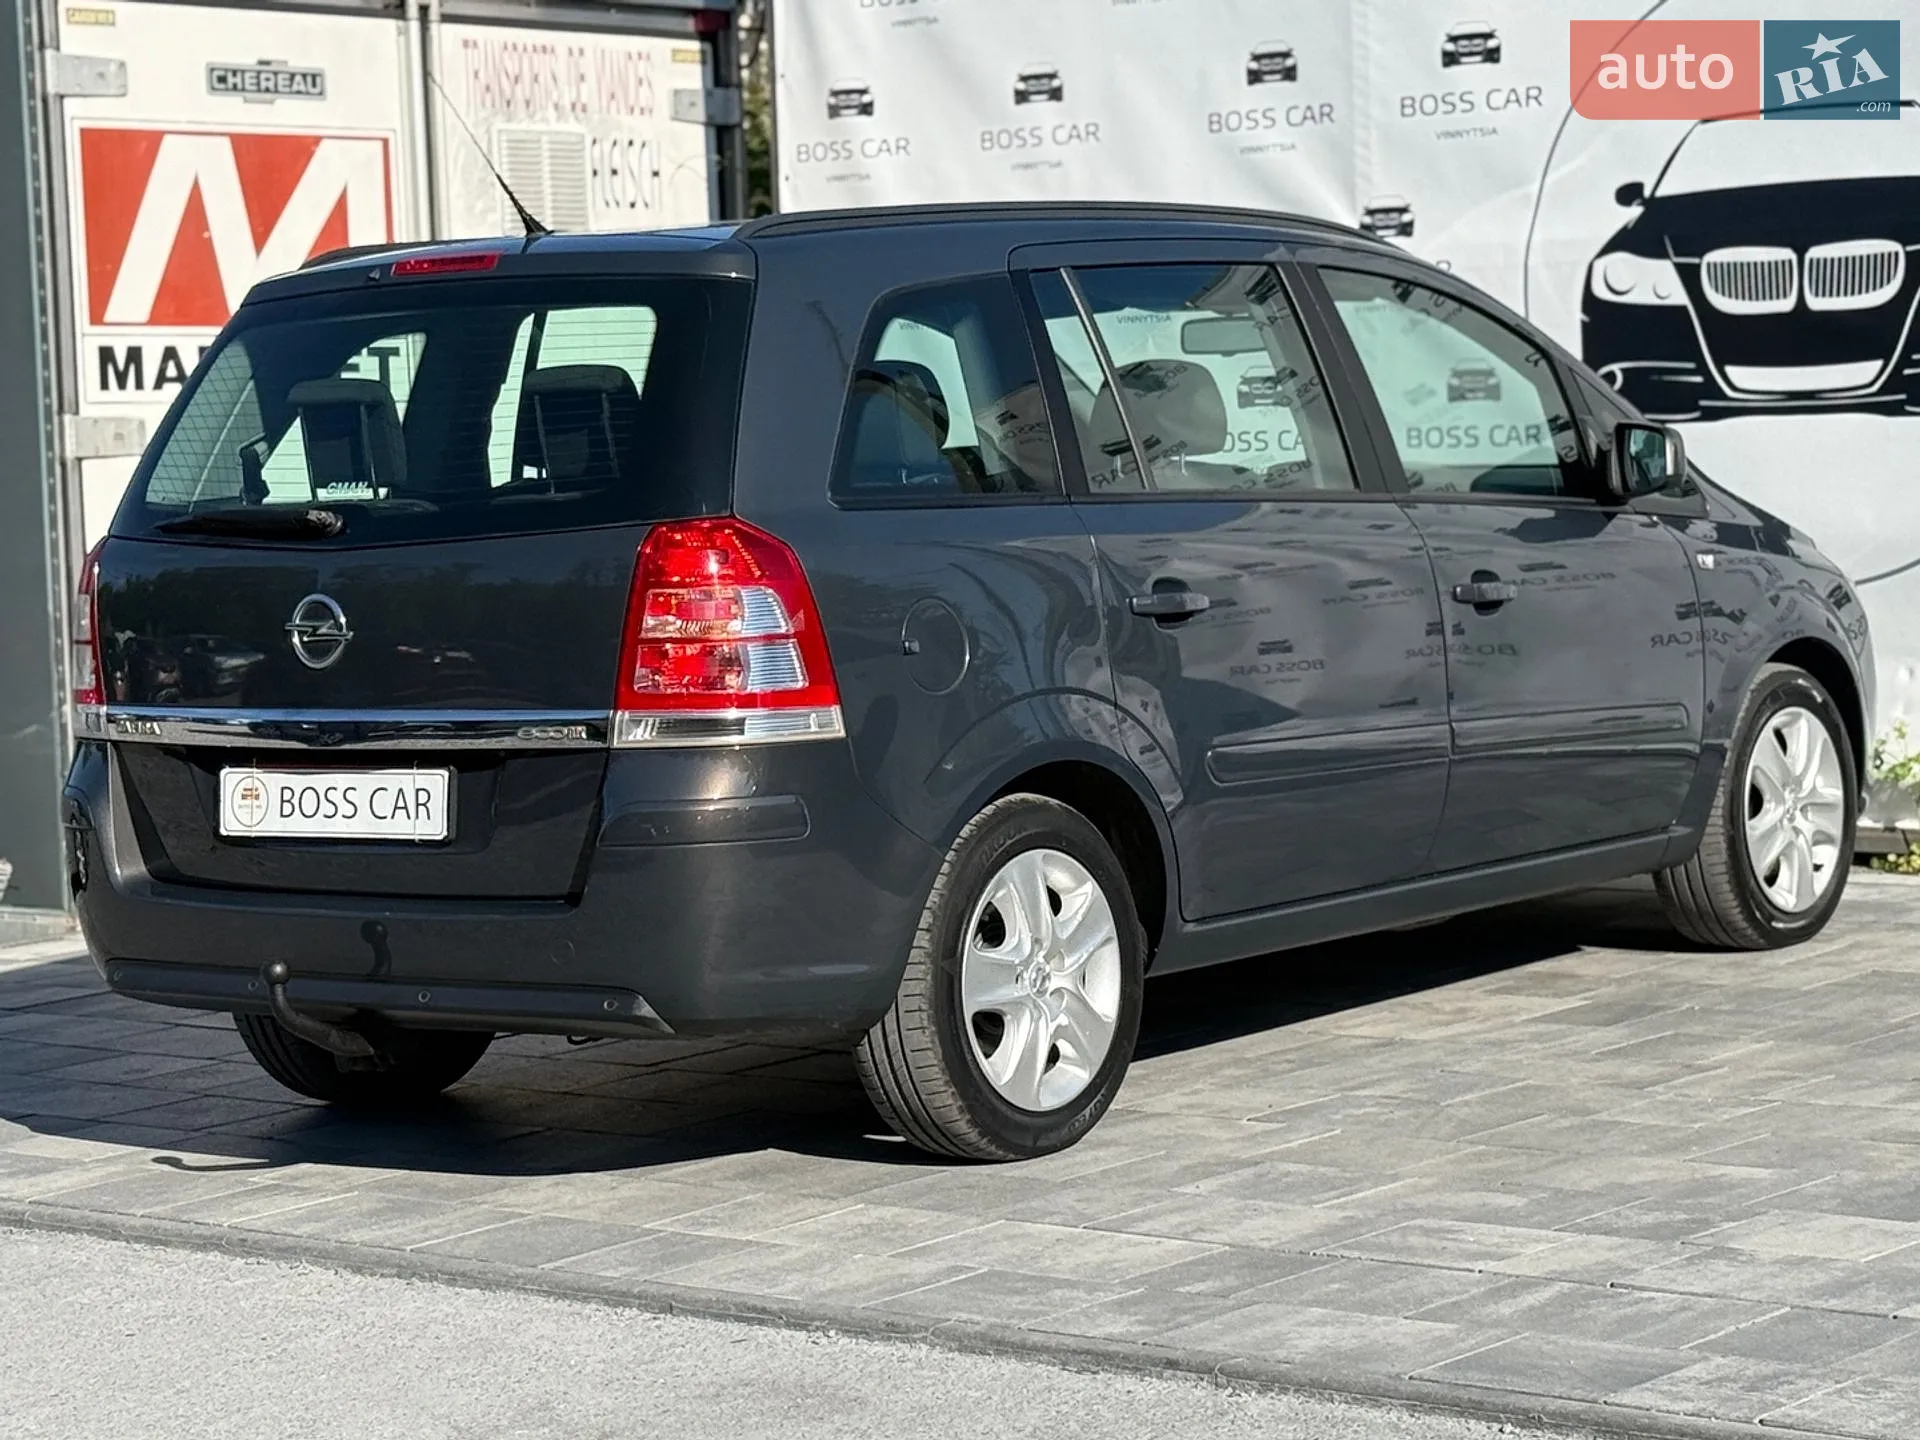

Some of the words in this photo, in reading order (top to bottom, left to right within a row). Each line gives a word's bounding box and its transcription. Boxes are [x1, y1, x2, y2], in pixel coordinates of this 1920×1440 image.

[211, 69, 323, 94] CHEREAU
[462, 38, 560, 115] TRANSPORTS
[567, 46, 588, 114] DE
[593, 46, 655, 117] VIANDES
[1399, 90, 1476, 118] BOSS
[1485, 85, 1543, 112] CAR
[1207, 107, 1277, 134] BOSS
[1285, 102, 1336, 128] CAR
[979, 125, 1044, 151] BOSS
[1051, 121, 1101, 145] CAR
[1434, 126, 1499, 141] VINNYTSIA
[796, 138, 854, 164] BOSS
[860, 136, 912, 158] CAR
[590, 136, 663, 213] FLEISCH
[1115, 313, 1173, 325] VINNYTSIA
[1406, 426, 1480, 449] BOSS
[1488, 424, 1543, 447] CAR
[279, 785, 358, 819] BOSS
[369, 786, 432, 821] CAR
